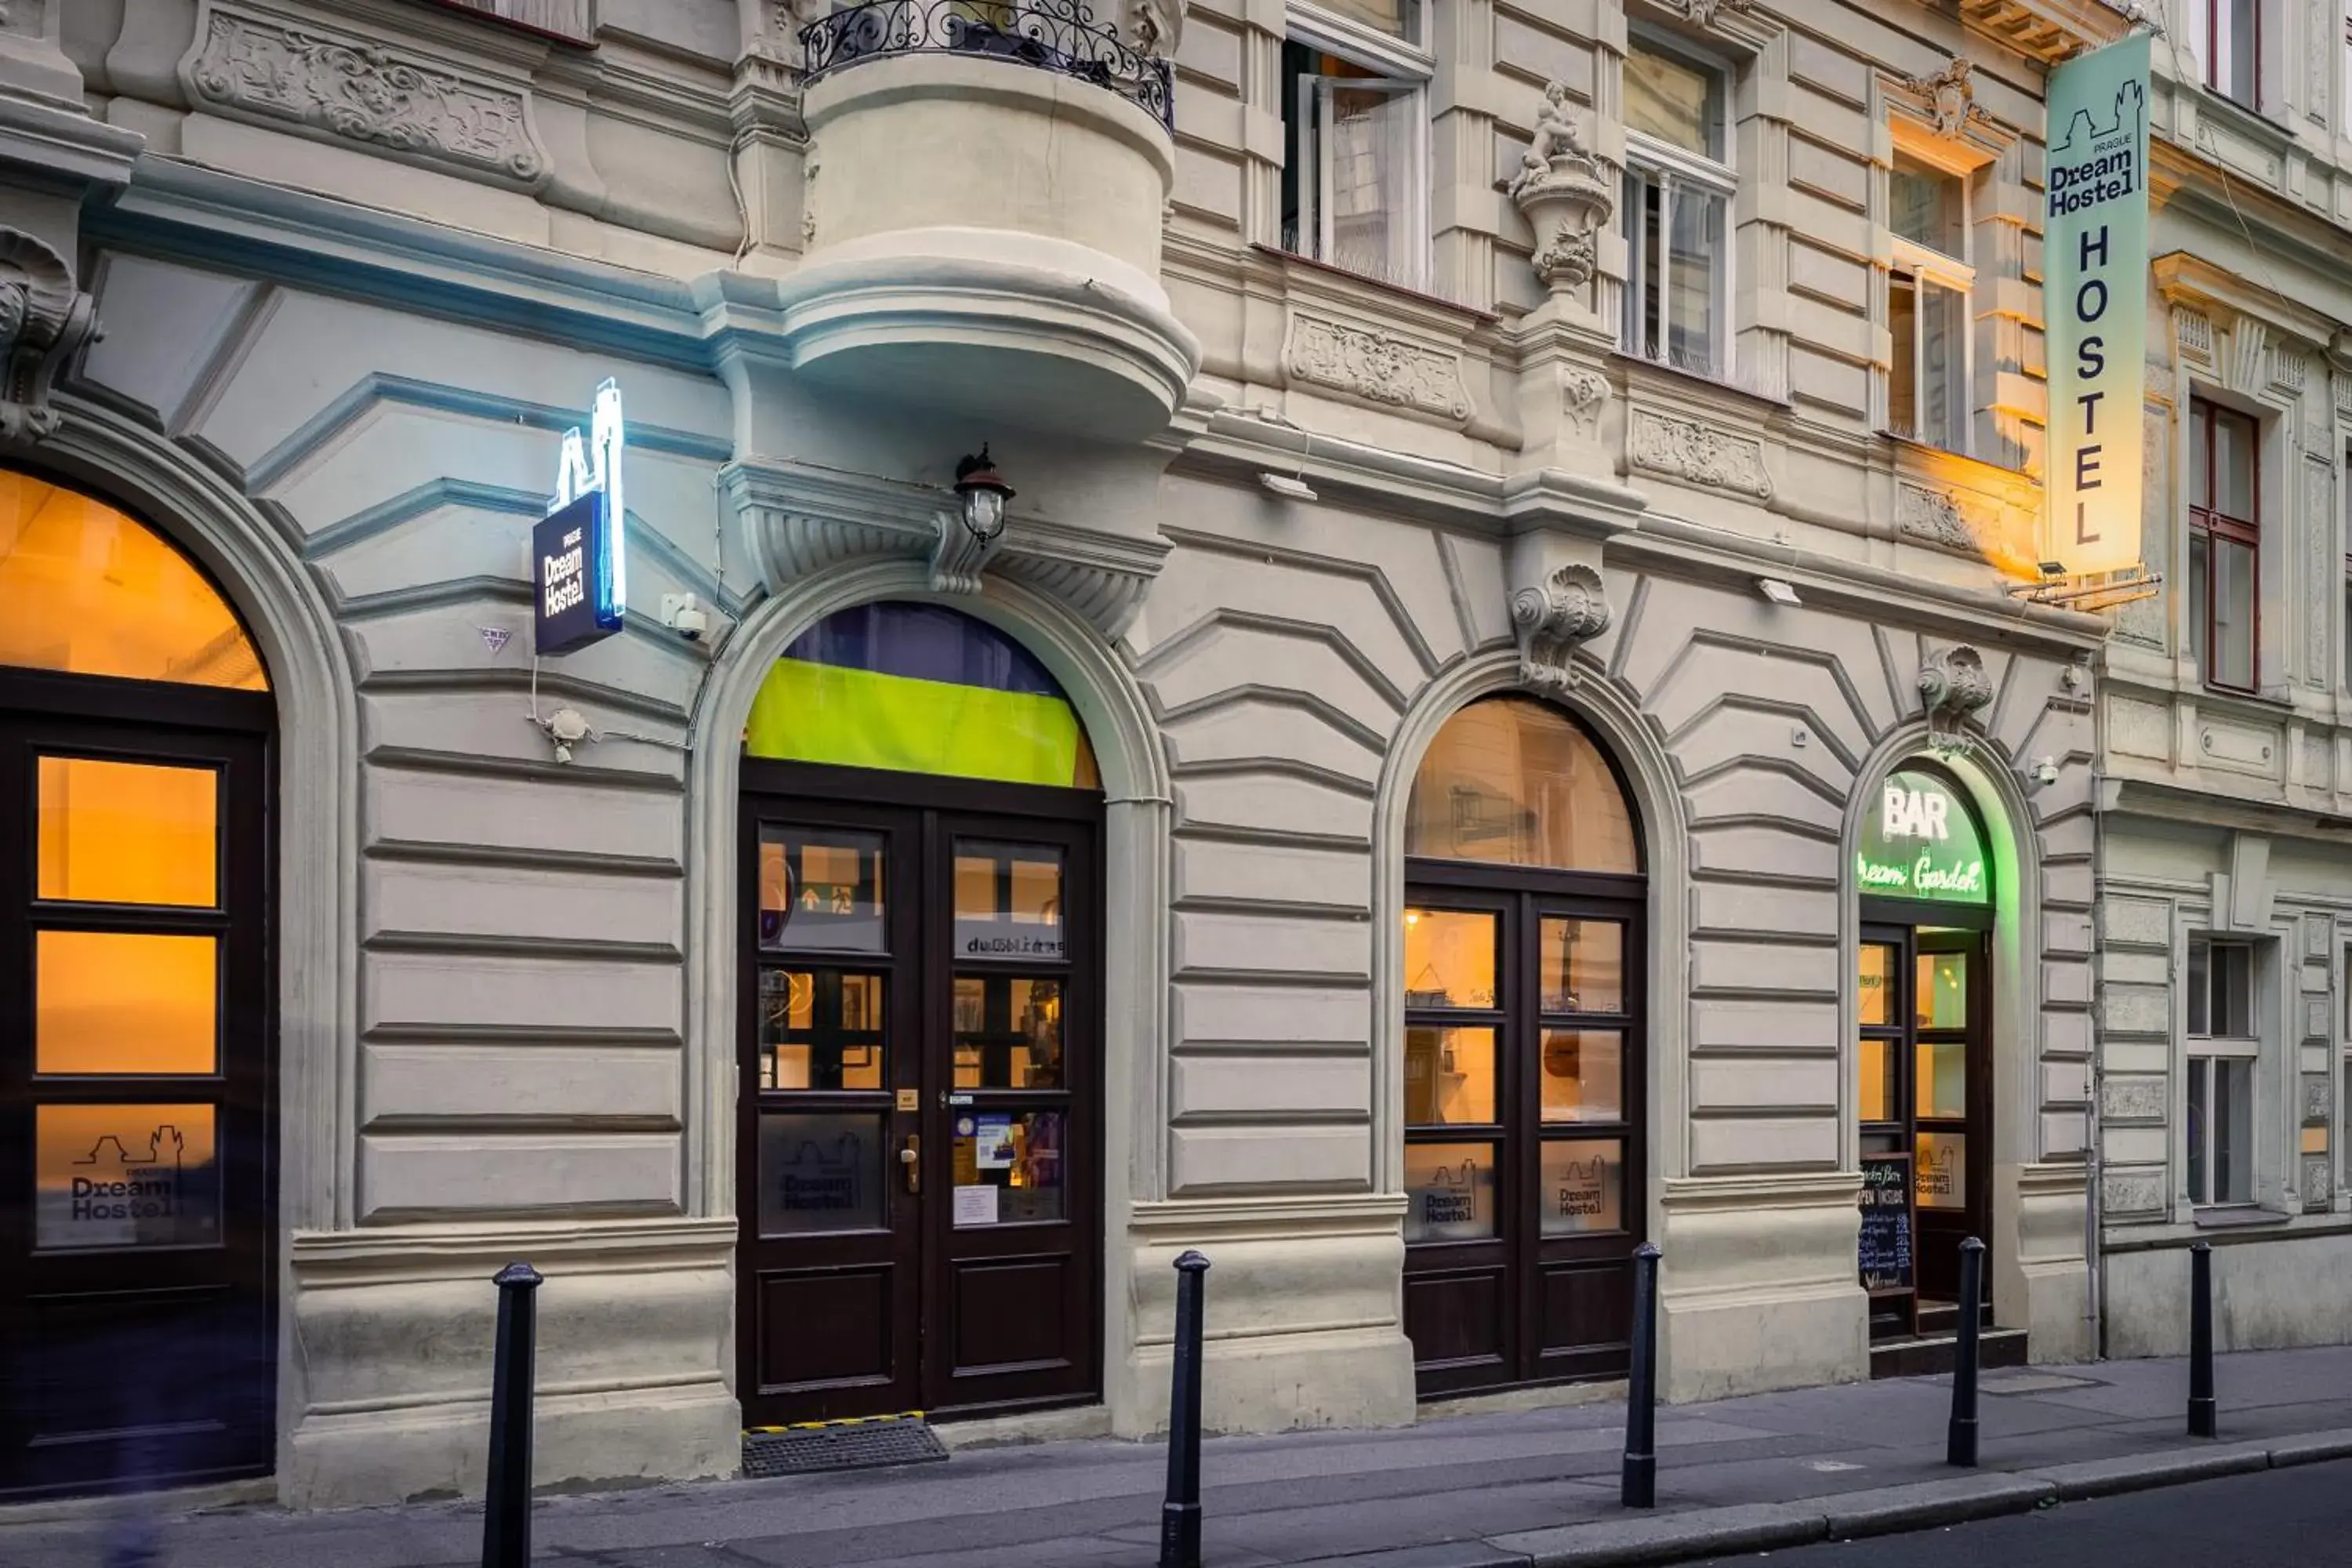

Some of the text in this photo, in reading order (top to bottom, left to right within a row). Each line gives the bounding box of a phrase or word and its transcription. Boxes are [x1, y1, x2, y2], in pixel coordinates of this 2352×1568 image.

[2094, 133, 2132, 154] PRAGUE
[2050, 150, 2131, 191] Dream
[2049, 169, 2132, 217] Hostel
[2076, 225, 2108, 546] HOSTEL
[544, 546, 583, 586] Dream
[546, 570, 584, 618] Hostel
[1883, 787, 1948, 840] BAR
[72, 1177, 171, 1198] Dream
[1559, 1189, 1600, 1202] Dream
[72, 1199, 175, 1221] Hostel
[1426, 1194, 1472, 1208] Dream
[1559, 1201, 1602, 1216] Hostel
[1426, 1207, 1472, 1224] Hostel
